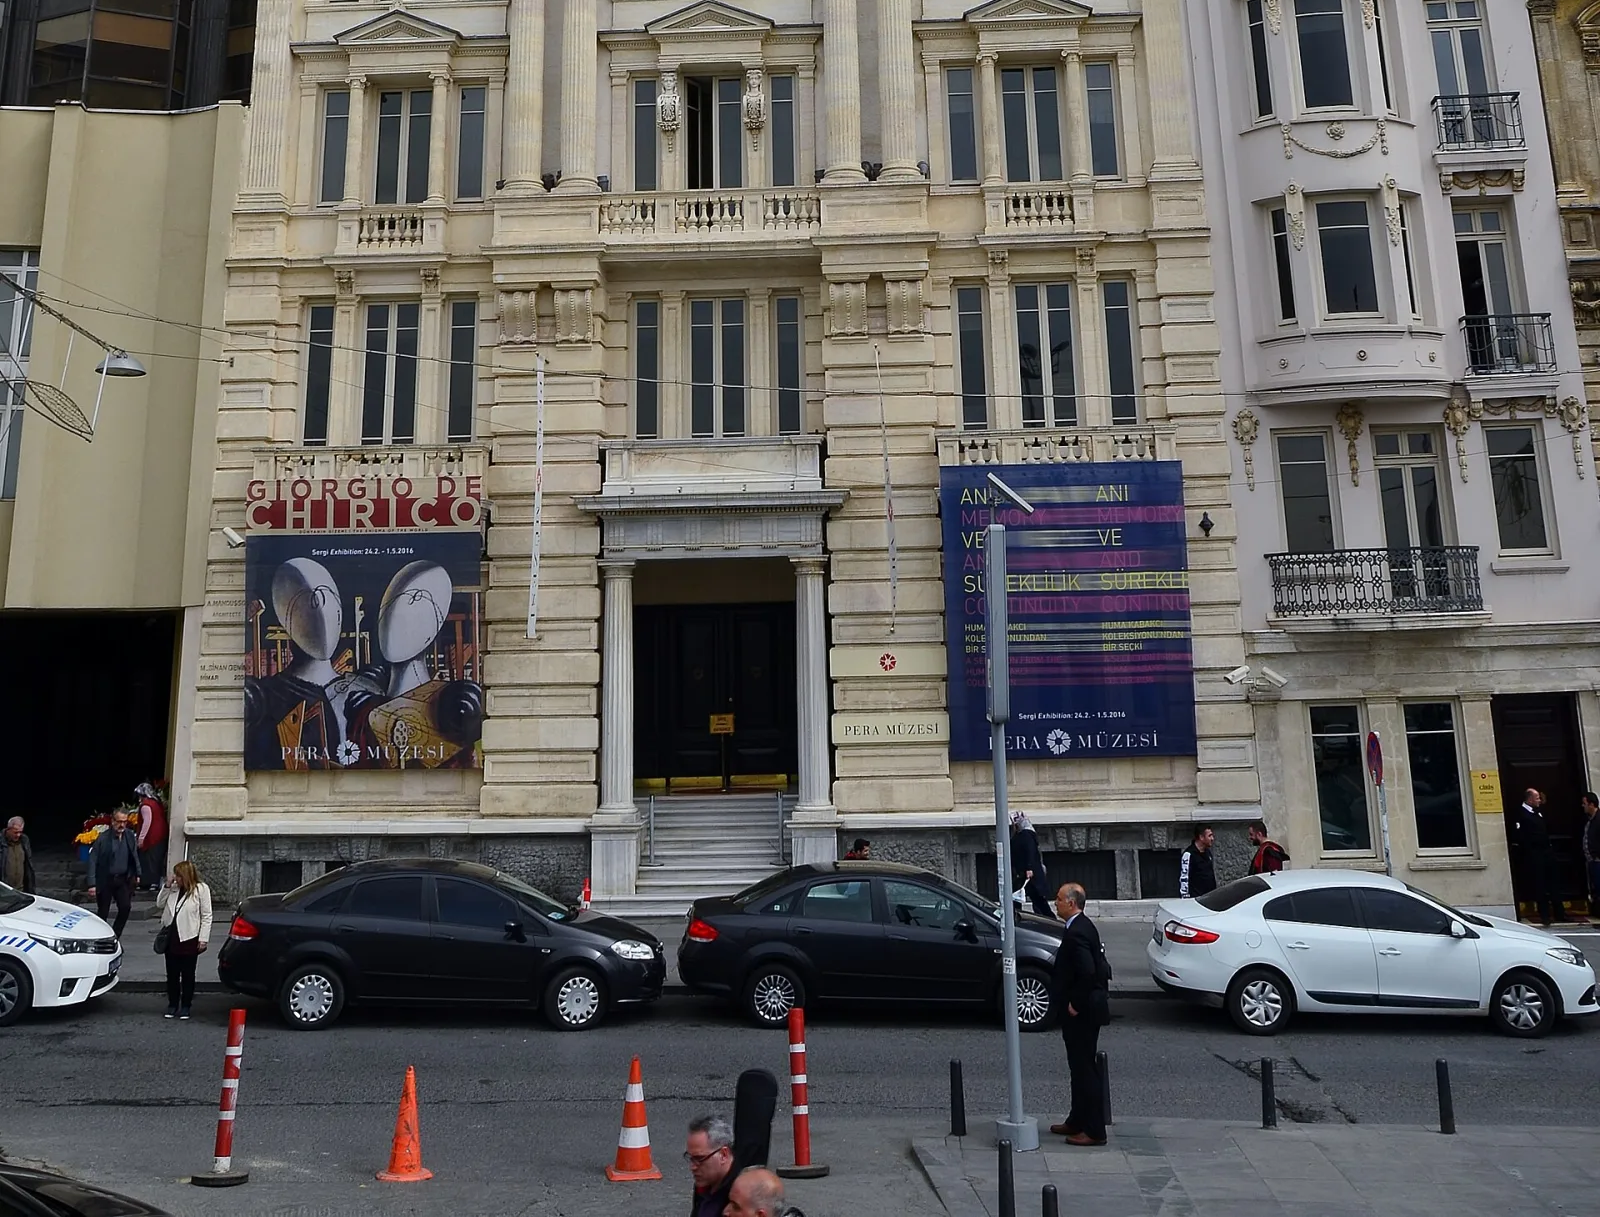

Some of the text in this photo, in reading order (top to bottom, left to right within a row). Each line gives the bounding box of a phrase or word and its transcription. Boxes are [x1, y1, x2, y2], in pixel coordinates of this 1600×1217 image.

[247, 475, 482, 501] GIORGIO DE
[1096, 484, 1128, 502] ANI
[246, 496, 481, 529] CHIRICO
[1097, 505, 1183, 524] MEMORY
[961, 531, 984, 549] VE
[1097, 528, 1123, 546] VE
[312, 548, 329, 557] Sergi
[330, 548, 364, 556] Exhibition:
[386, 547, 414, 555] 1.5.2016
[1101, 551, 1140, 568] AND
[963, 554, 985, 571] AN
[1102, 621, 1126, 630] HUMA
[1103, 640, 1143, 652] BİR SEÇKİ
[1018, 712, 1037, 721] Sergi
[1038, 712, 1073, 720] Exhibition:
[1074, 711, 1091, 719] 24.2.
[1096, 711, 1126, 719] 1.5.2016
[844, 722, 938, 736] PERA MÜZESİ
[1077, 730, 1158, 749] MÜZESİ
[281, 741, 445, 761] PERA MÜZESİ
